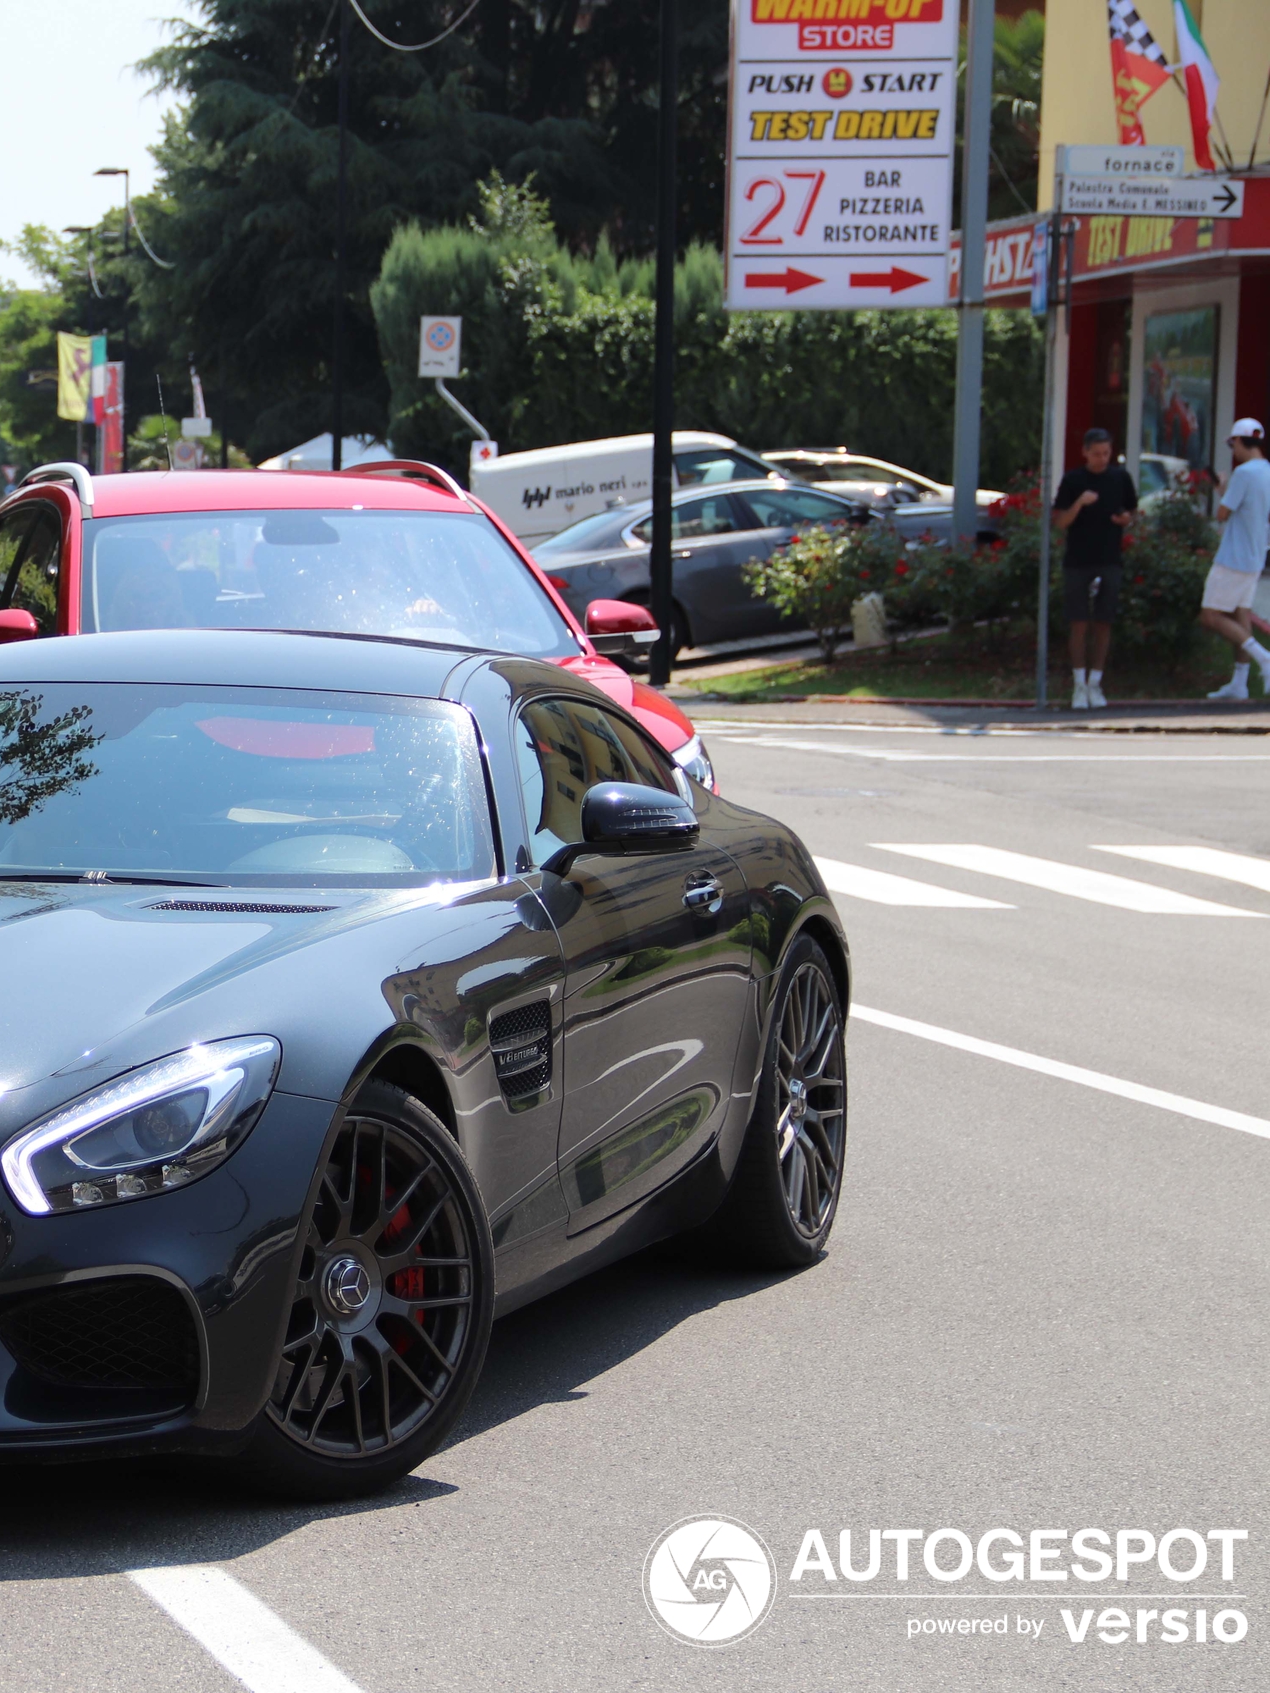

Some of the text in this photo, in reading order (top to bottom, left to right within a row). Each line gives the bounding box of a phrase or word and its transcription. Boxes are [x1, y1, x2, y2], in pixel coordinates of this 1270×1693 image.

[802, 25, 892, 47] STORE
[748, 73, 942, 93] PUSH START
[750, 109, 939, 141] TEST DRIVE
[1104, 157, 1175, 172] fornace
[864, 171, 901, 188] BAR
[1068, 181, 1170, 195] Palestra Comunale
[739, 168, 826, 245] 27
[839, 198, 924, 215] PIZZERIA
[1068, 198, 1103, 209] Scuola
[1107, 198, 1137, 210] Media
[824, 225, 939, 242] RISTORANTE
[555, 482, 594, 498] mario
[599, 475, 627, 493] neri
